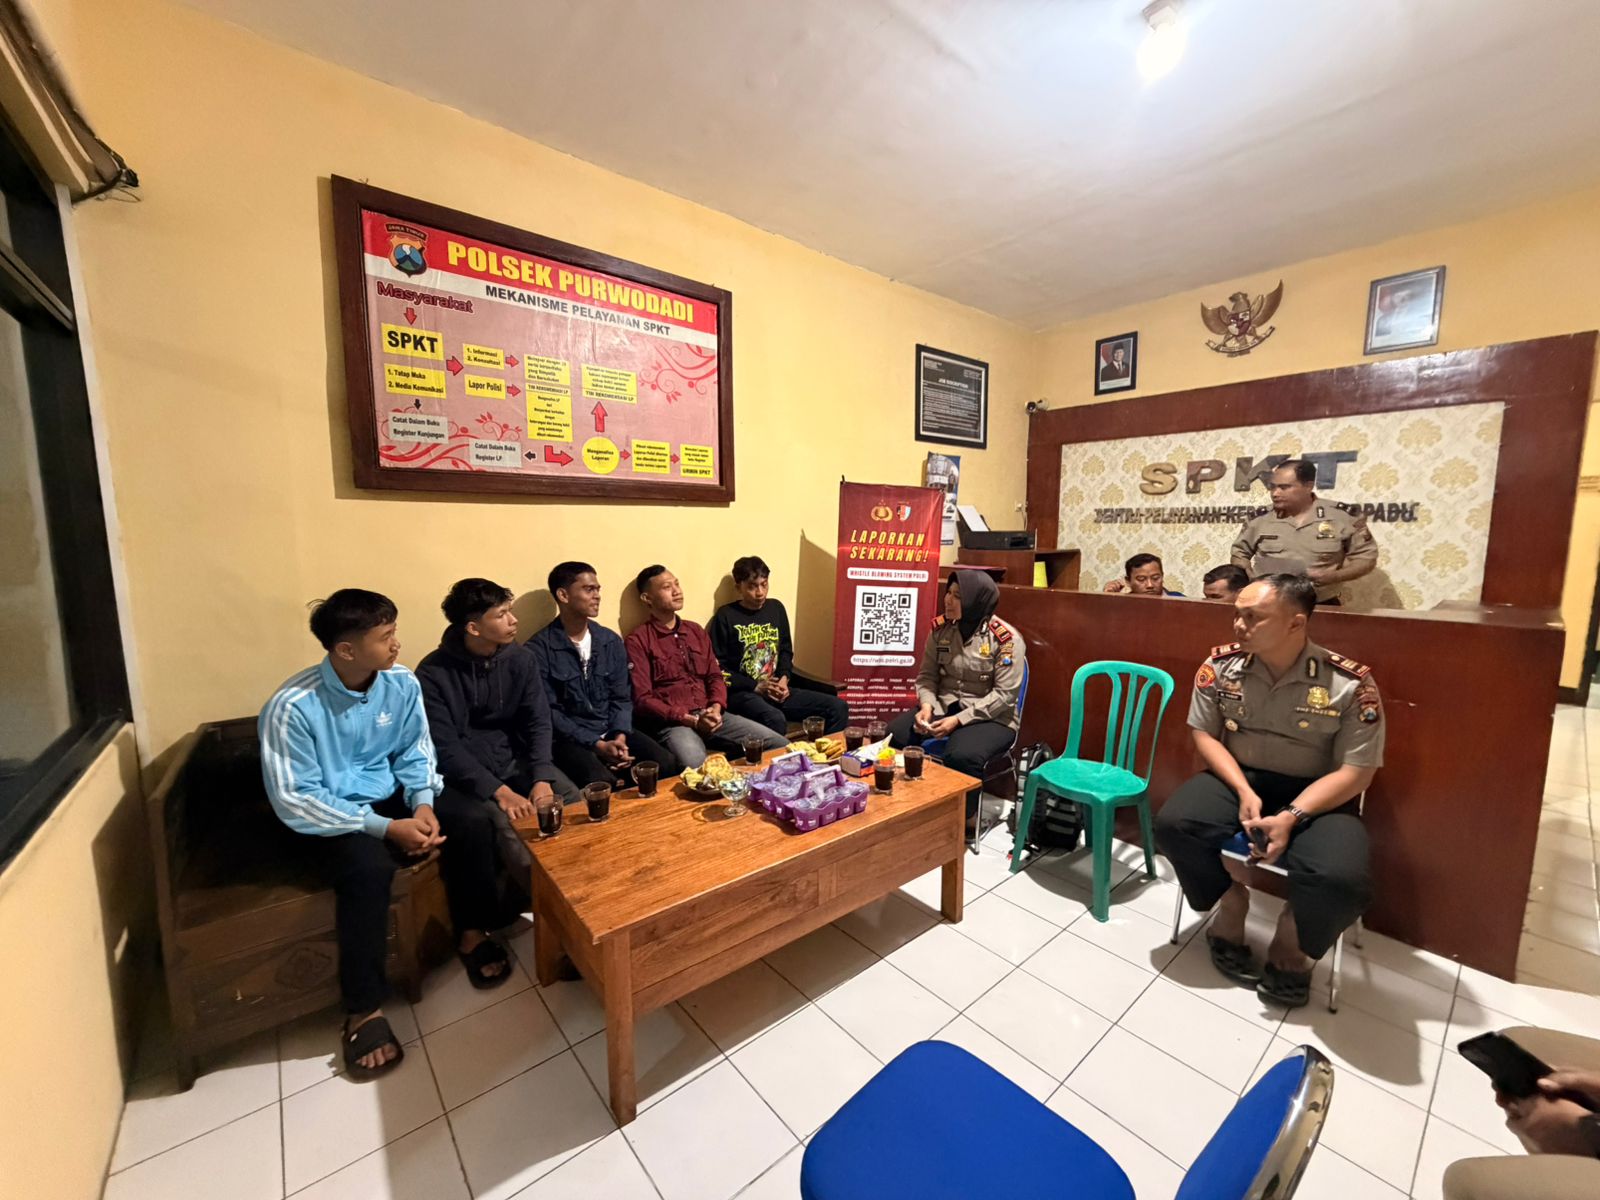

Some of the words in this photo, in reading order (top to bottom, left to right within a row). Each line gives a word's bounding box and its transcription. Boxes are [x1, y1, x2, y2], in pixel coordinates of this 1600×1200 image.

[447, 240, 553, 288] POLSEK
[559, 269, 694, 323] PURWODADI
[377, 281, 473, 313] Masyarakat
[486, 285, 568, 313] MEKANISME
[572, 304, 640, 329] PELAYANAN
[643, 321, 670, 336] SPKT
[387, 330, 438, 353] SPKT
[468, 379, 485, 391] Lapor
[486, 382, 502, 392] Polisi
[1140, 450, 1358, 495] SPKT
[850, 530, 925, 547] LAPORKAN
[849, 546, 929, 562] SEKARANG!
